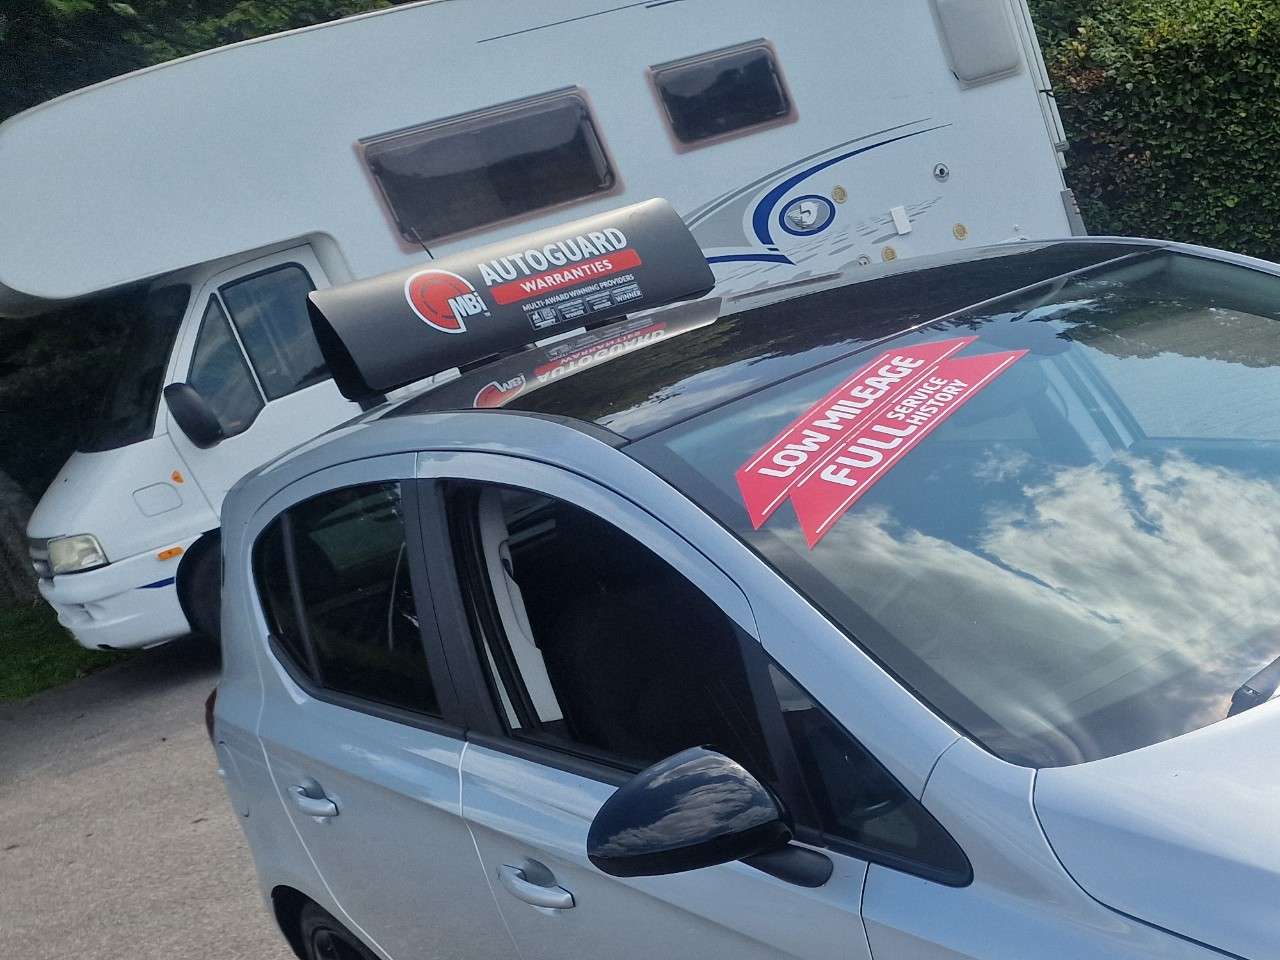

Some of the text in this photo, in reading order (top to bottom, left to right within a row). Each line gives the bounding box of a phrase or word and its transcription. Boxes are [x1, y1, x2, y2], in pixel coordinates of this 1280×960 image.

[478, 227, 627, 286] AUTOGUARD
[520, 259, 613, 292] WARRANTIES
[522, 292, 570, 312] MULTI-AWARD
[569, 284, 600, 298] WINNING
[599, 273, 635, 289] PROVIDERS
[615, 290, 642, 302] WINNER
[758, 355, 925, 478] LOW MILEAGE
[887, 376, 949, 421] SERVICE
[906, 379, 968, 426] HISTORY
[821, 424, 918, 487] FULL
